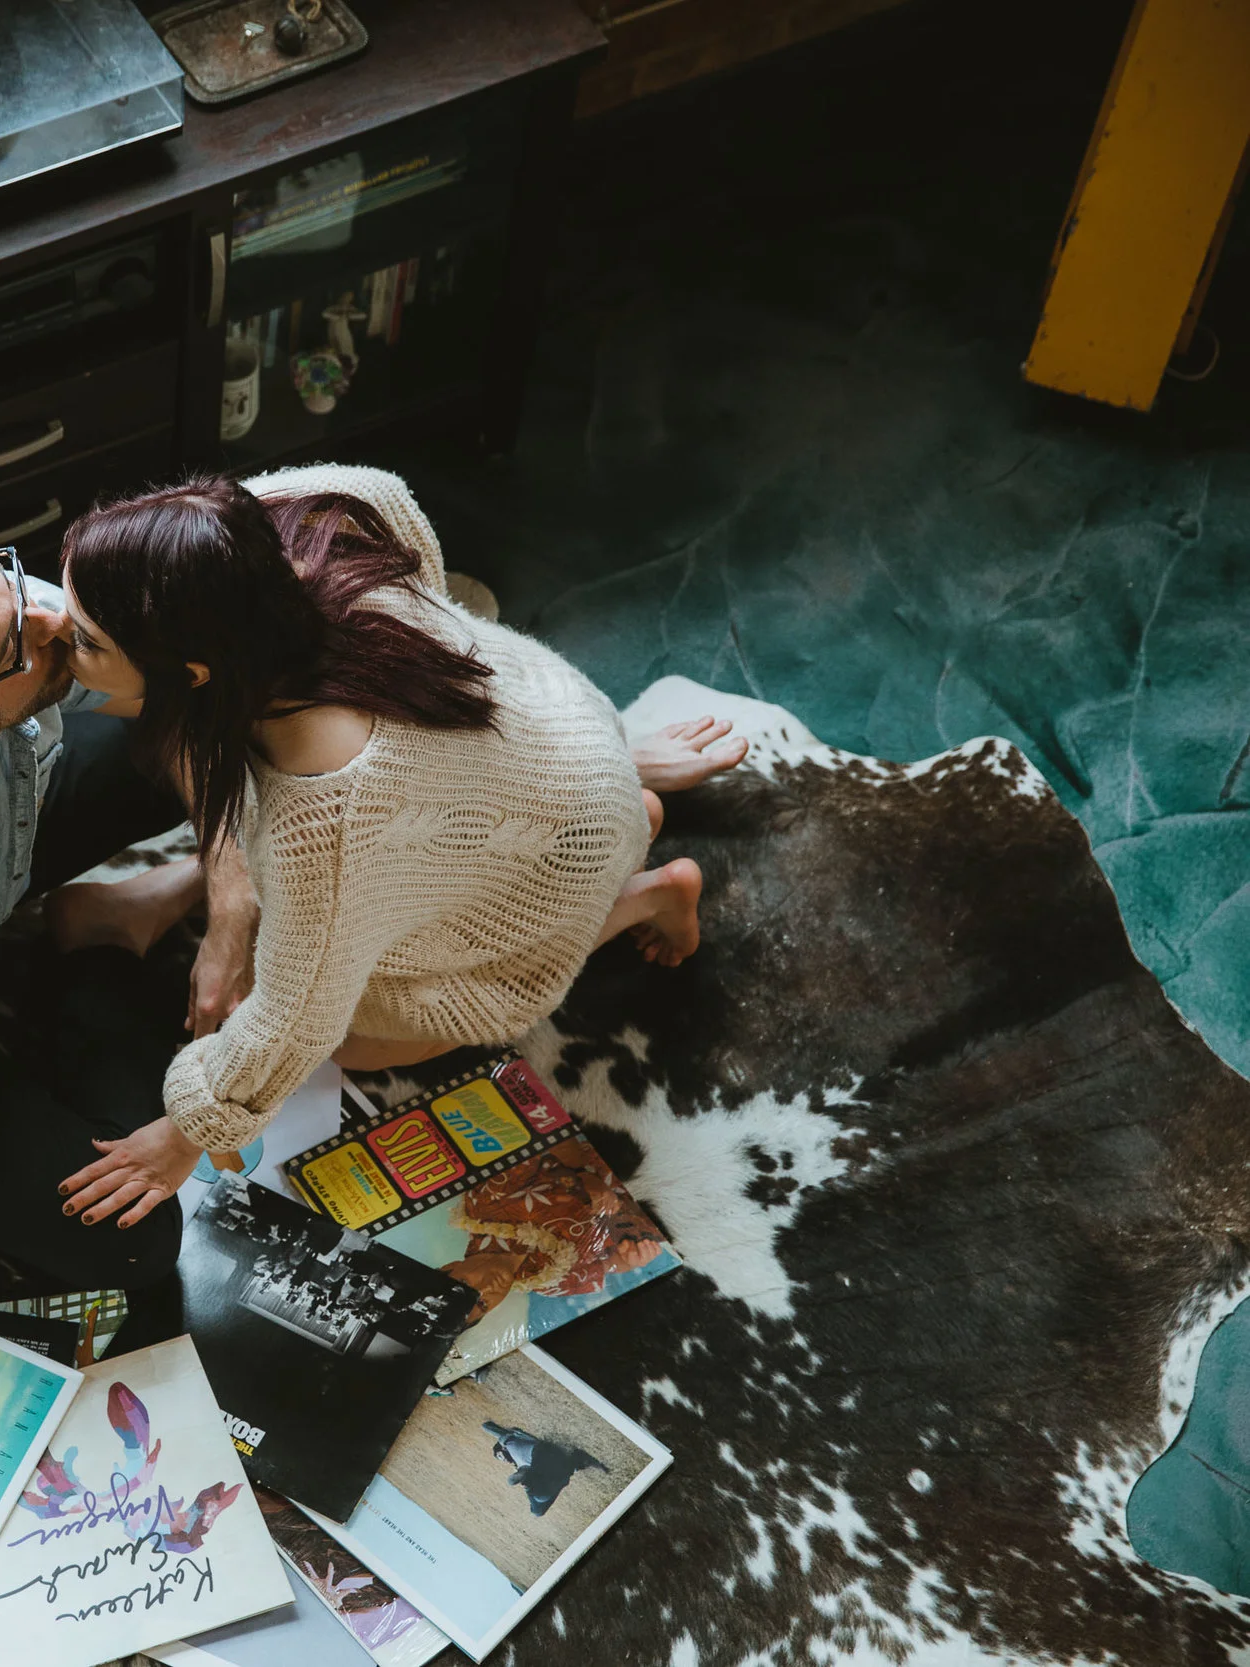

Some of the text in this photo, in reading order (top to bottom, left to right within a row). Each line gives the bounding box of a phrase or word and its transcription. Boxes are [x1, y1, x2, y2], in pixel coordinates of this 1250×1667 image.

[527, 1105, 557, 1129] 14
[440, 1109, 503, 1153] BLUE
[375, 1118, 457, 1193] ELVIS
[306, 1169, 330, 1199] STEREO
[14, 1377, 54, 1432] RYAN
[220, 1409, 266, 1448] BOX
[235, 1439, 255, 1456] THE
[381, 1516, 398, 1530] HEART
[396, 1528, 406, 1538] THE
[405, 1536, 416, 1546] AND
[415, 1544, 428, 1556] HEAD
[428, 1555, 437, 1564] THE
[56, 1557, 214, 1622] Kathleen
